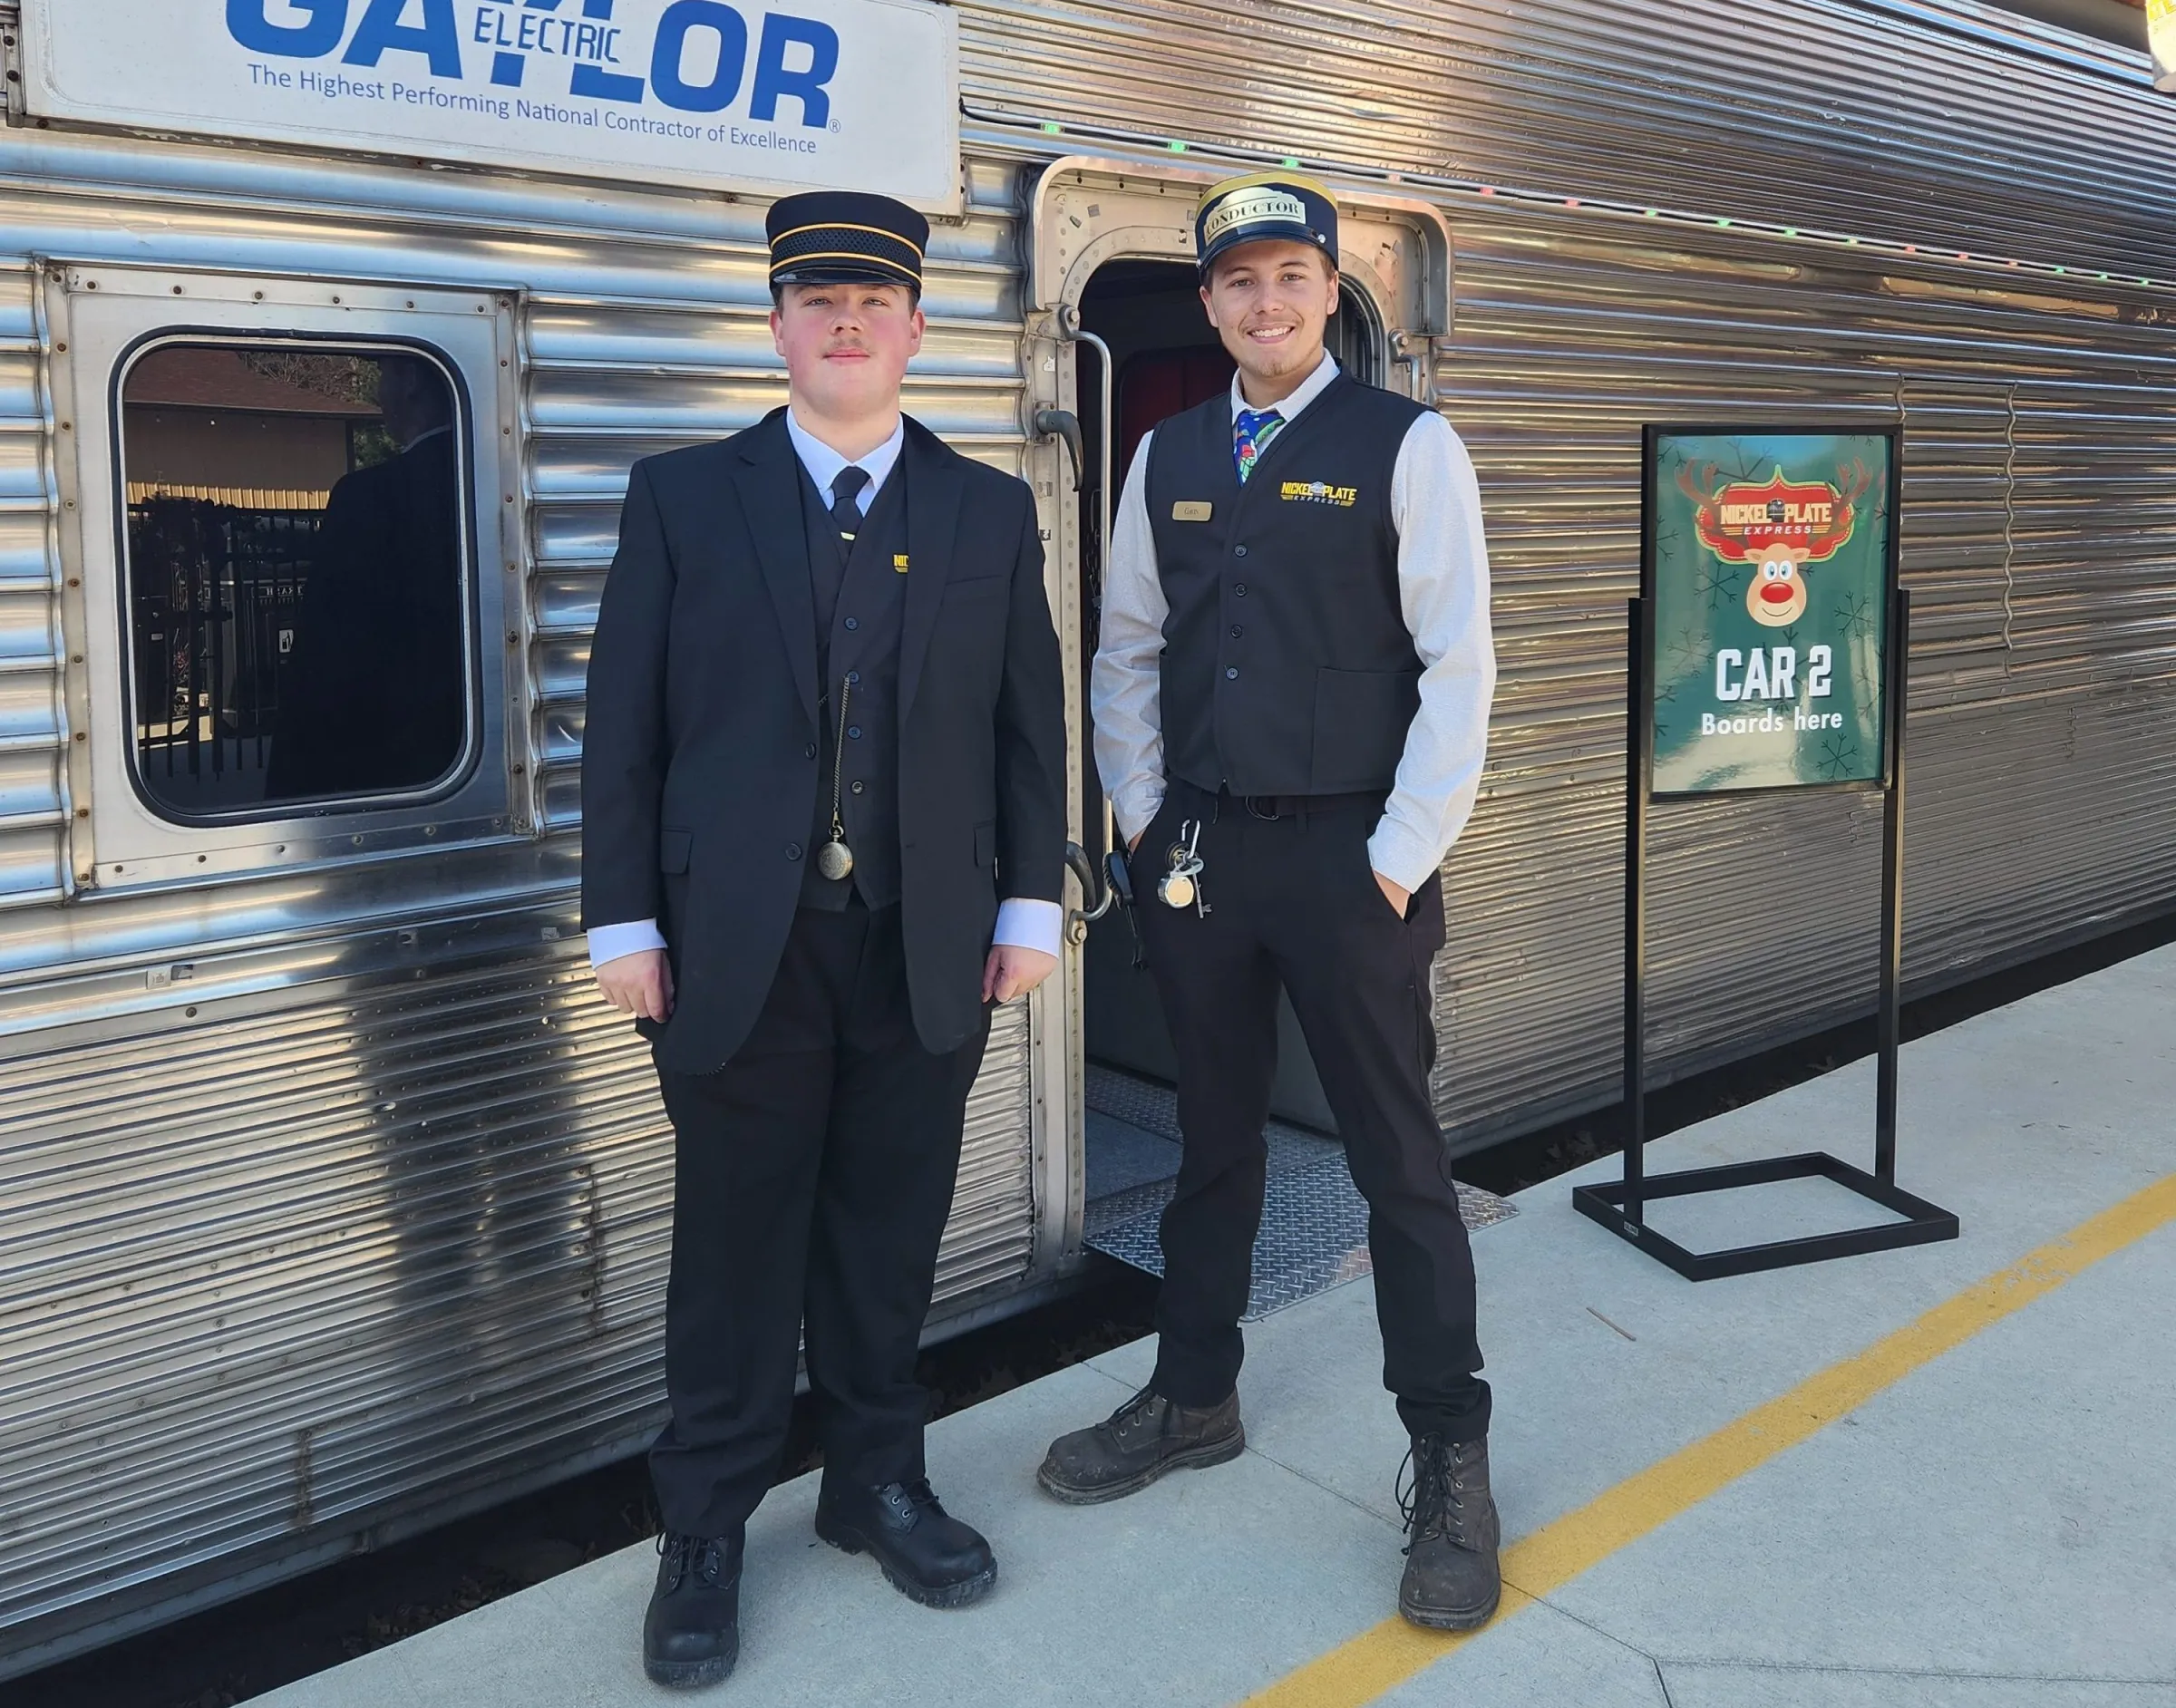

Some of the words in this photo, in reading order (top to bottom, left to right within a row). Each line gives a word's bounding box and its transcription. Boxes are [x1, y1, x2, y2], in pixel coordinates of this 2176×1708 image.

[474, 7, 621, 63] ELECTRIC
[248, 63, 291, 88] The
[300, 70, 384, 100] Highest
[393, 83, 510, 120] Performing
[517, 100, 598, 127] National
[605, 112, 702, 139] Contractor
[708, 125, 725, 141] of
[731, 127, 816, 153] Excellence
[1207, 201, 1299, 235] CONDUCTOR
[1281, 481, 1314, 496] NICKEL
[1322, 485, 1357, 500] PLATE
[1294, 495, 1340, 505] EXPRESS
[1721, 504, 1772, 524] NICKEL
[1784, 503, 1831, 523] PLATE
[1744, 525, 1812, 536] EXPRESS
[1716, 646, 1795, 701] CAR
[1809, 645, 1832, 697] 2
[1702, 707, 1783, 735] Boards
[1795, 706, 1843, 731] here
